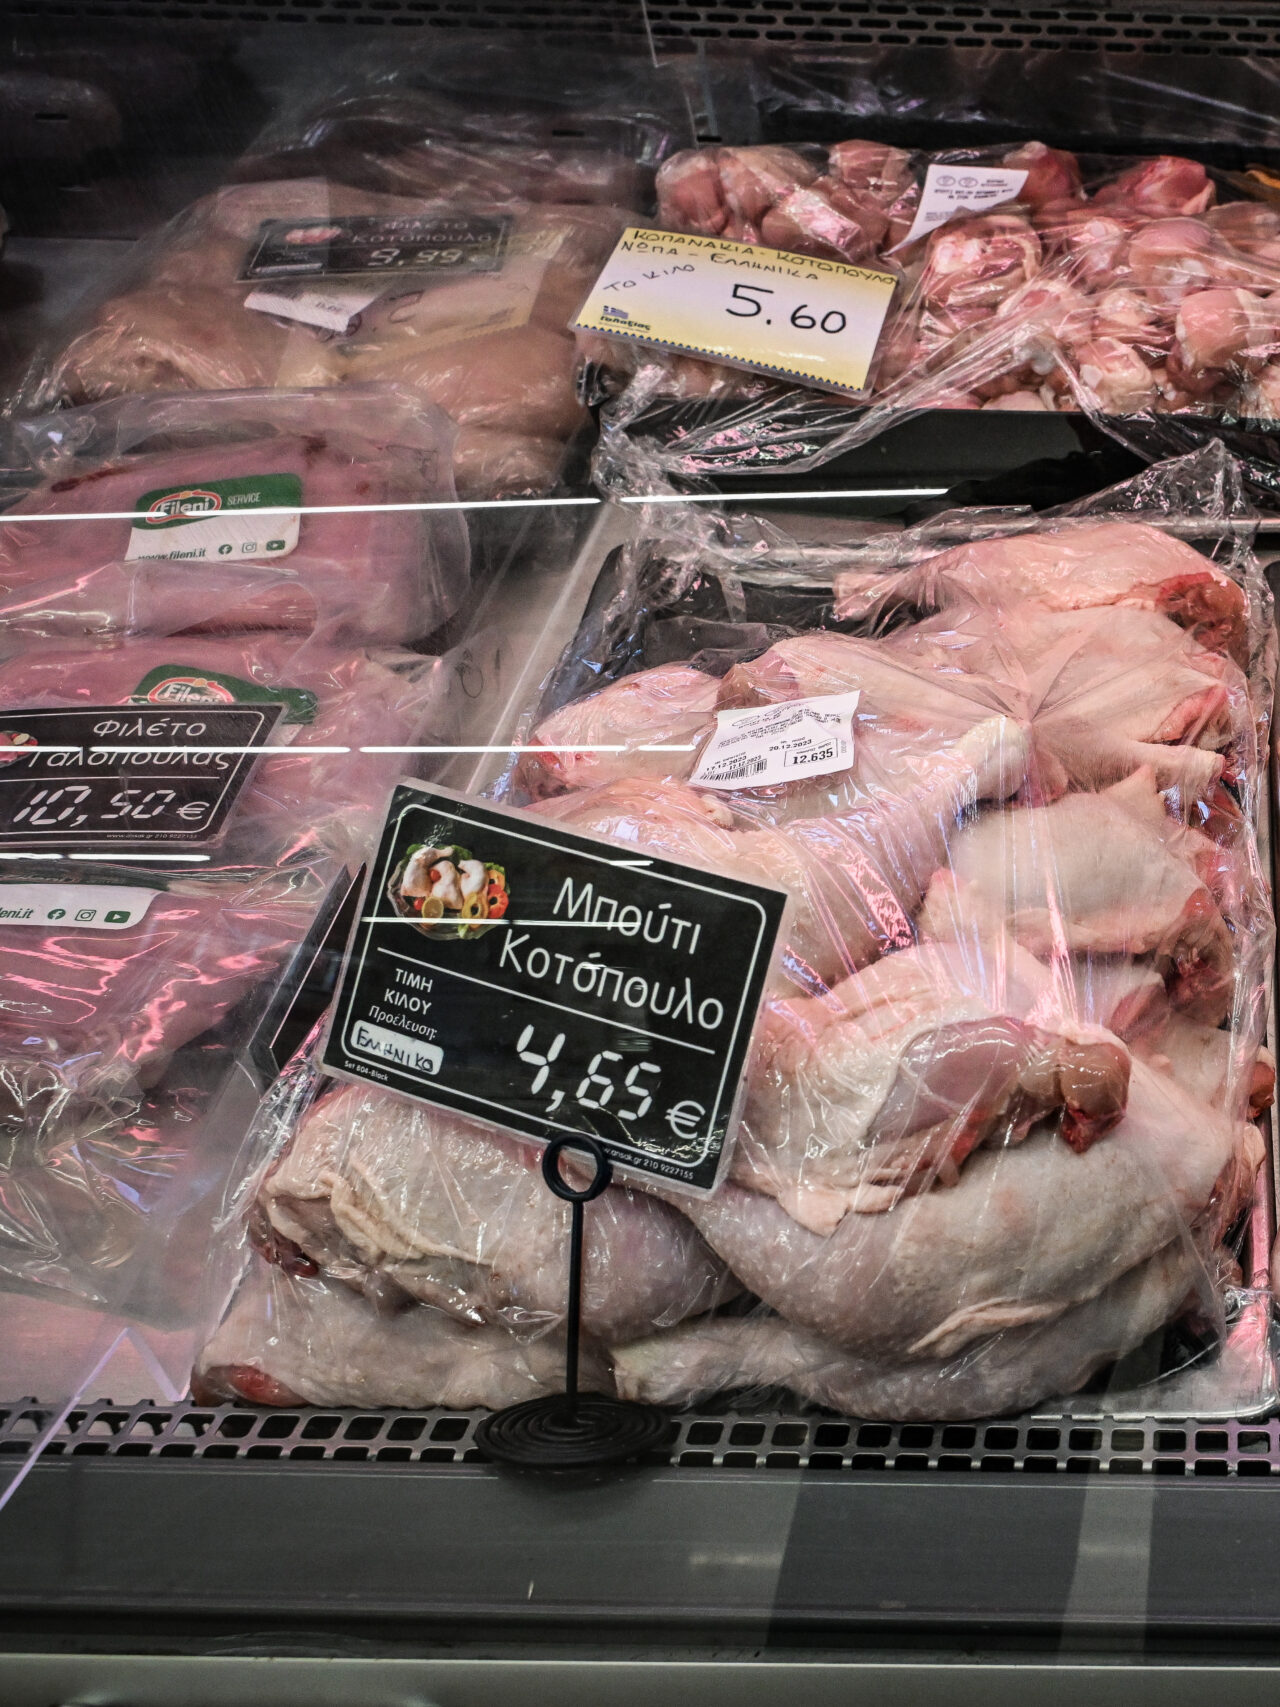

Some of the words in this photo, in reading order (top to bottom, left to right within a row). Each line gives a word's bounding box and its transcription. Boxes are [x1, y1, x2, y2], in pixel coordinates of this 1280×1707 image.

[726, 283, 847, 334] 5.60
[160, 497, 210, 515] Fileni
[227, 492, 261, 506] SERVICE
[93, 717, 207, 737] Φιλέτο
[792, 747, 833, 765] 12.635
[13, 785, 177, 828] 10,50
[553, 877, 702, 955] Μπούτι
[395, 968, 433, 993] ΤΙΜΗ
[499, 929, 724, 1030] Κοτόπουλο
[384, 988, 432, 1015] ΚΙΛΟΥ
[516, 1024, 661, 1121] 4,65
[665, 1101, 706, 1139] €
[643, 1160, 659, 1170] 210
